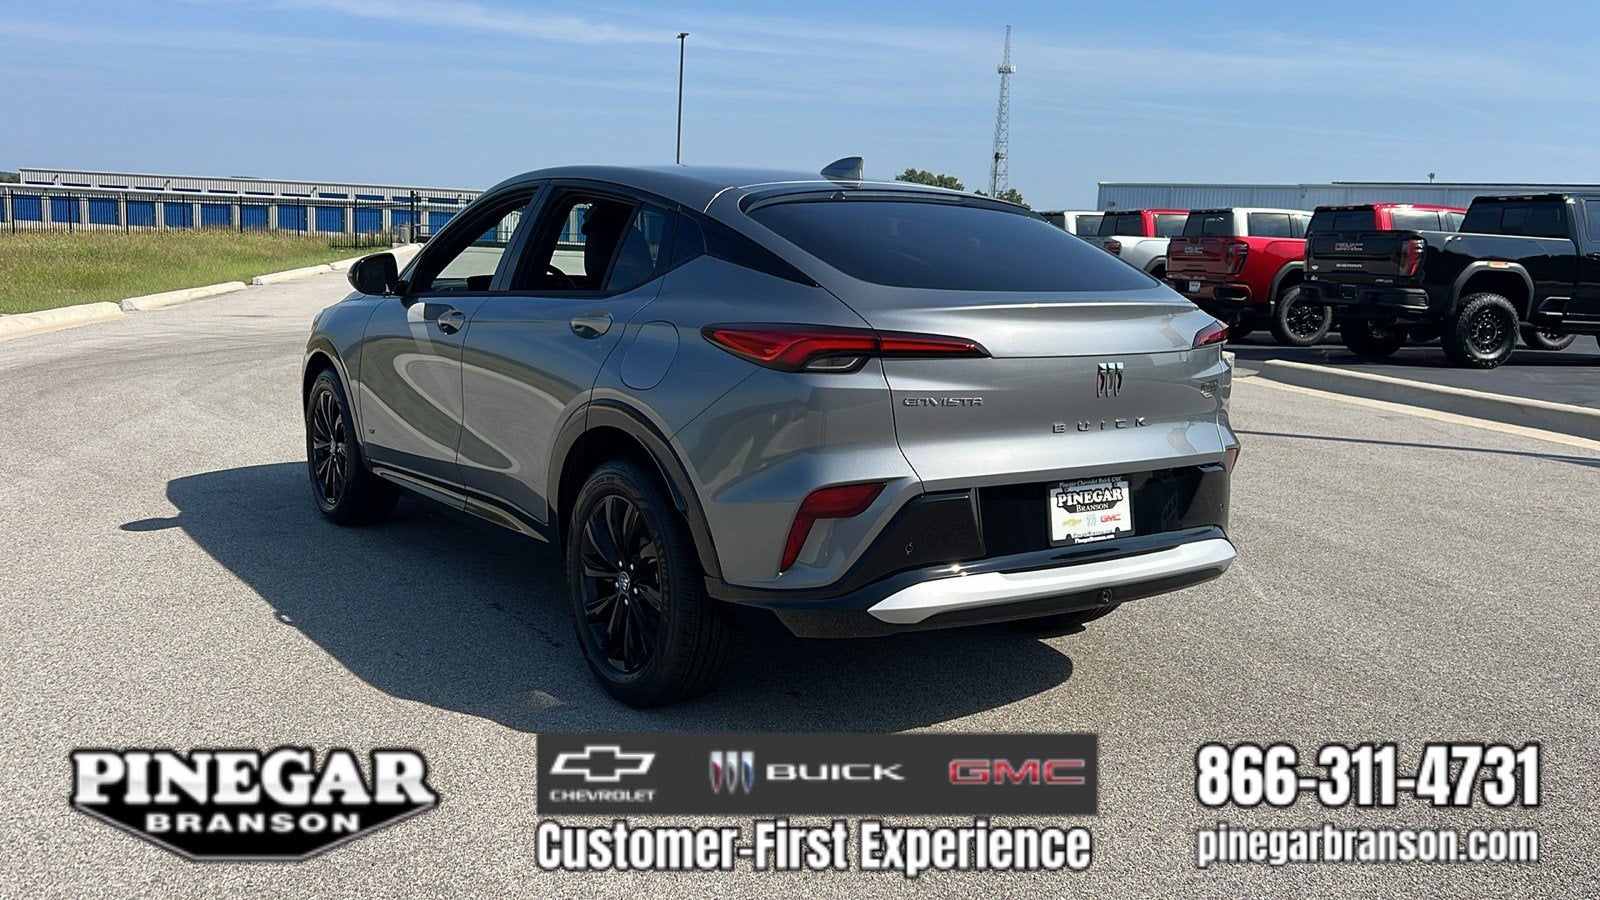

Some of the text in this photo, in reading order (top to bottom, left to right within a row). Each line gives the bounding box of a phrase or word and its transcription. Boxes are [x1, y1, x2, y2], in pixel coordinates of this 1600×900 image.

[903, 397, 984, 407] ENVISTA
[1052, 416, 1148, 434] BUICK
[1057, 488, 1122, 507] PINEGAR
[1100, 514, 1121, 523] GMC
